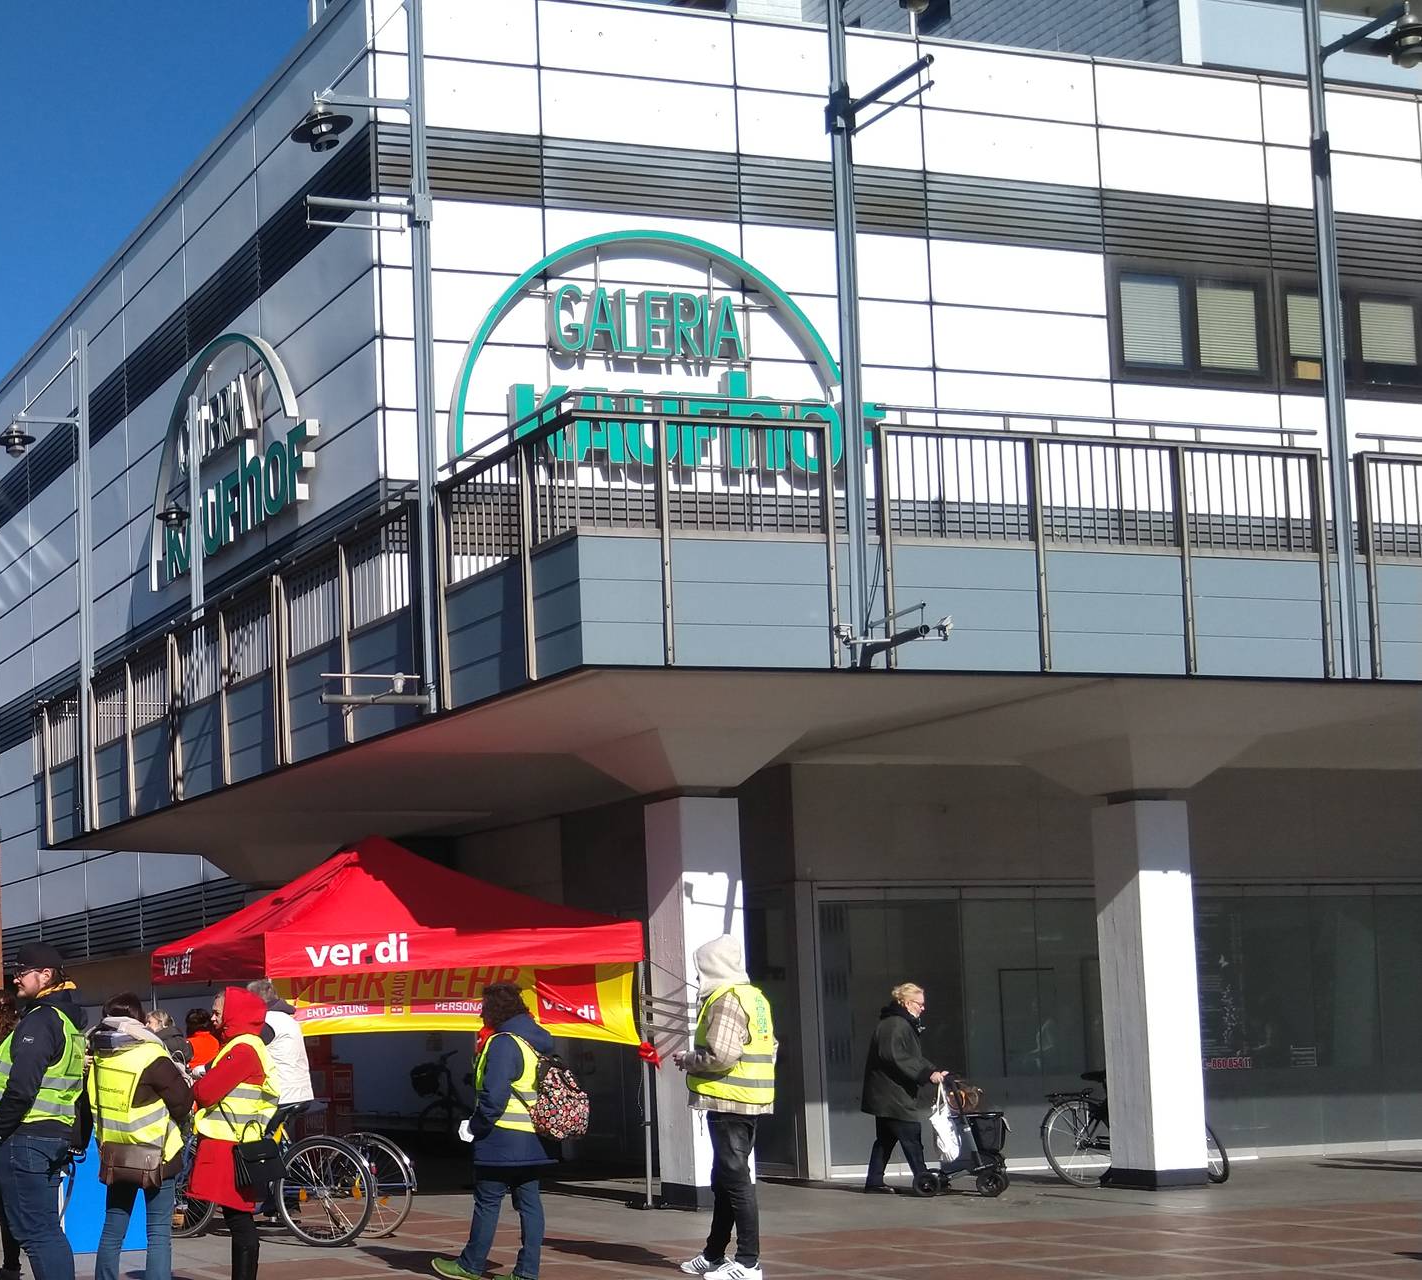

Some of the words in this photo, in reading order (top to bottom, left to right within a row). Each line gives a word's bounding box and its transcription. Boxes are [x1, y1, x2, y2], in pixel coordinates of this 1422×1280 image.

[552, 284, 745, 360] GALERIA
[305, 932, 409, 967] ver.di
[306, 1004, 369, 1018] ENTLASTUNG
